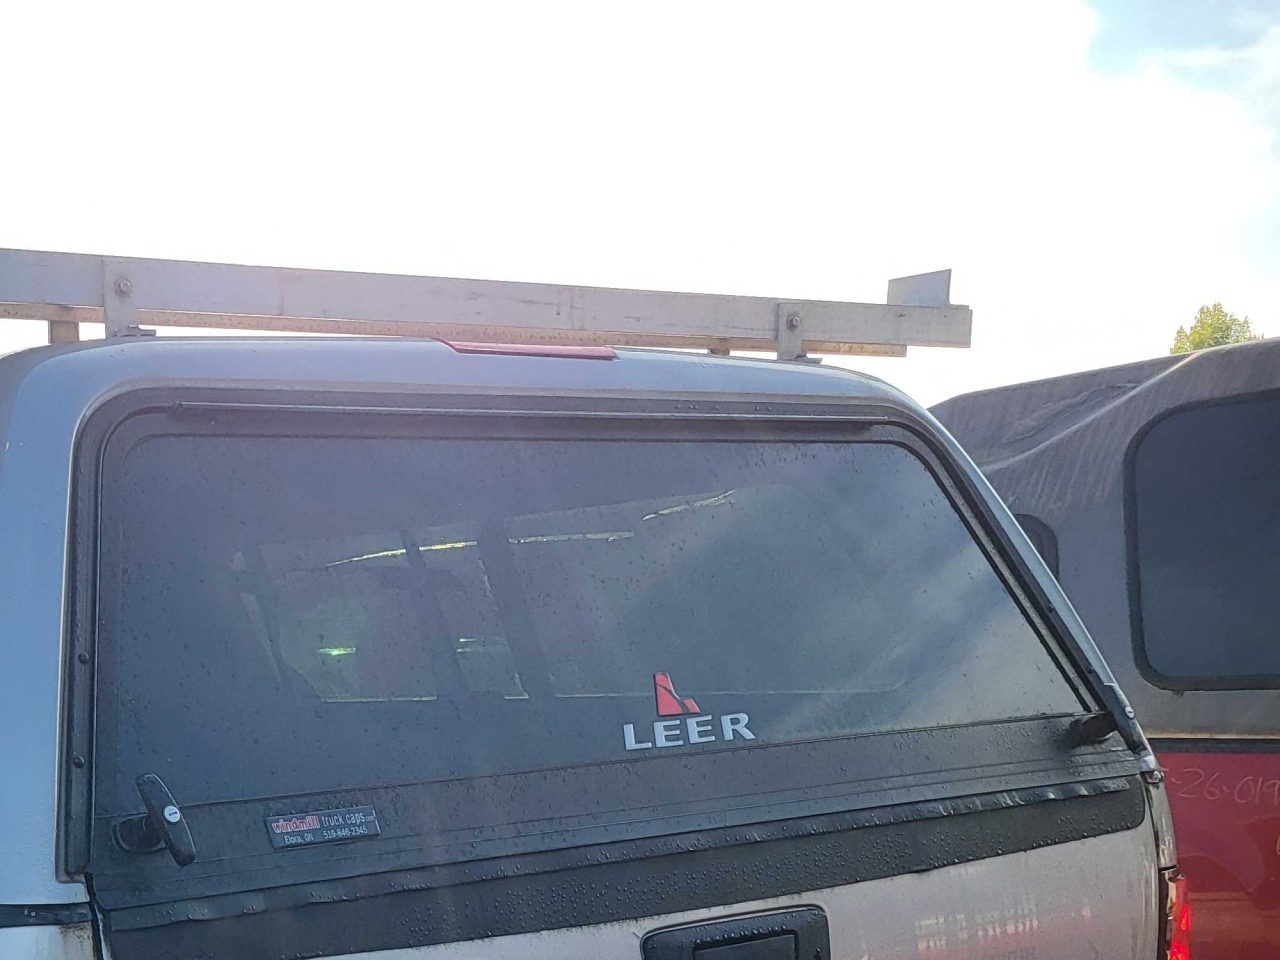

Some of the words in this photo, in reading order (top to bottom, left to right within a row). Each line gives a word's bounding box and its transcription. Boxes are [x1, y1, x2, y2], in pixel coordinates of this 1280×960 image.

[623, 713, 756, 750] LEER
[272, 816, 320, 833] windmill
[321, 813, 344, 827] truck
[284, 834, 303, 844] Elora,
[304, 833, 314, 841] ON
[323, 826, 368, 839] 519-846-2345
